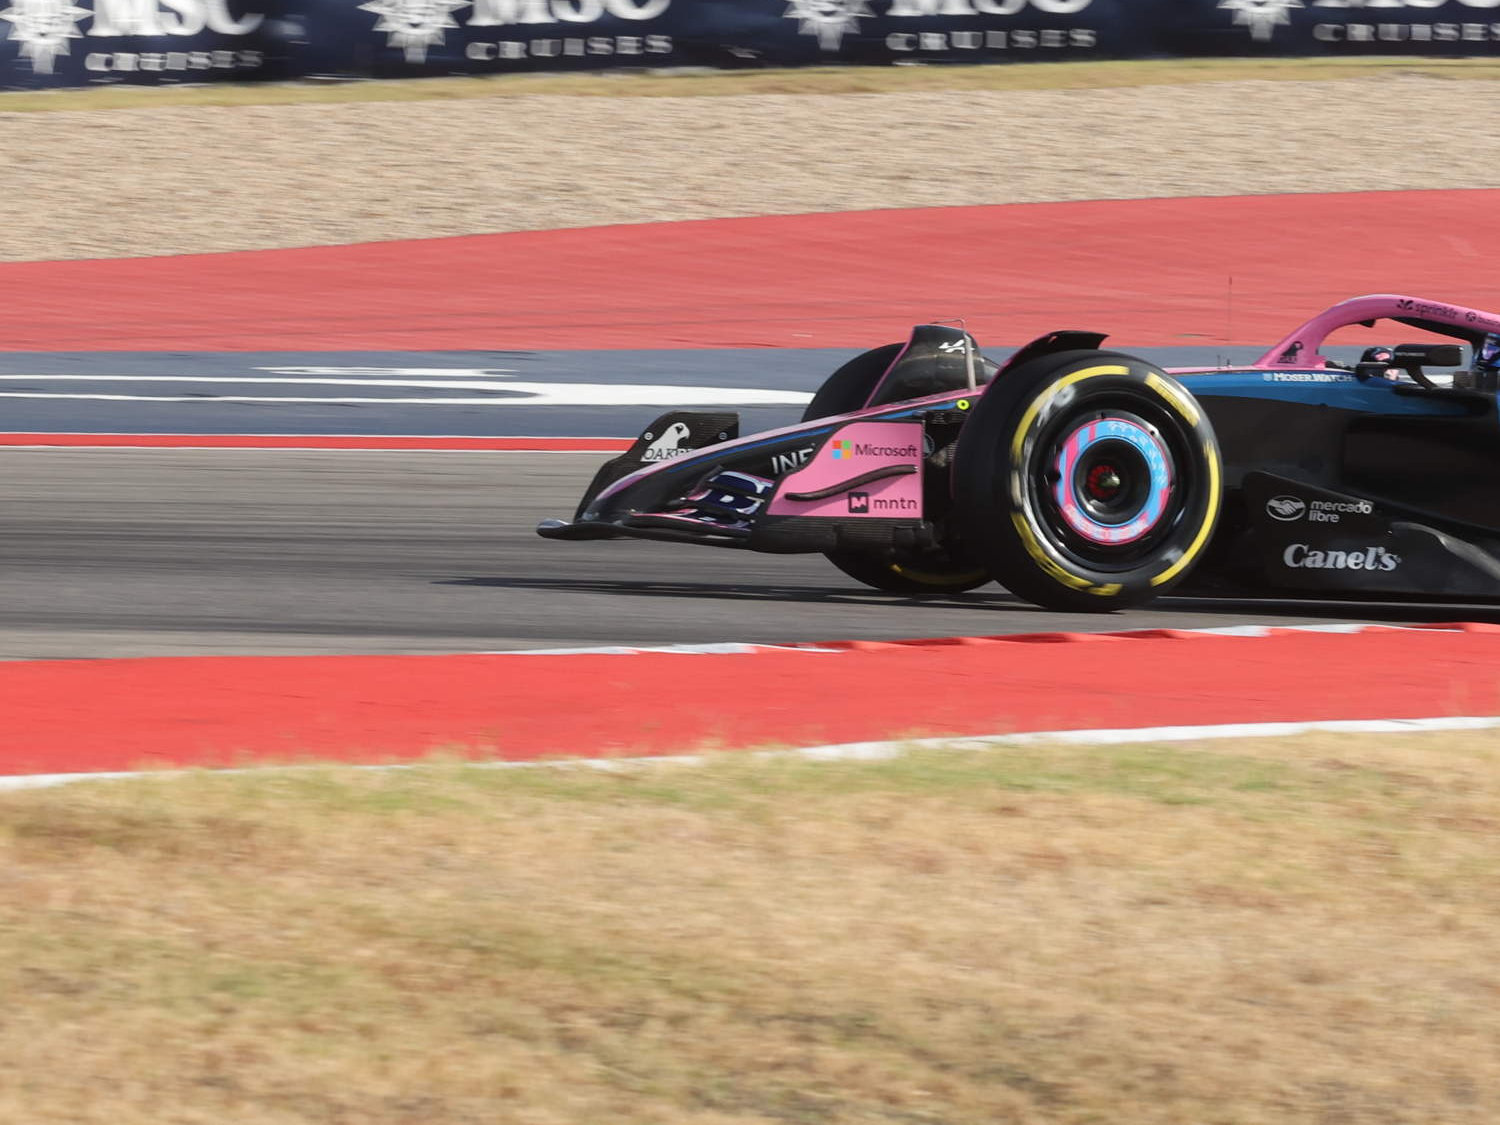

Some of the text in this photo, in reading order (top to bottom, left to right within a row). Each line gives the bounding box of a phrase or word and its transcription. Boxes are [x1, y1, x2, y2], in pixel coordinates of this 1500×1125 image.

[466, 34, 673, 61] CRUISES
[885, 28, 1097, 50] CRUISES
[84, 50, 264, 72] CRUISES
[855, 442, 918, 458] Microsoft
[873, 496, 918, 510] mntn
[1310, 499, 1374, 514] mercado
[1308, 509, 1340, 523] libre
[1283, 543, 1399, 571] Canel's
